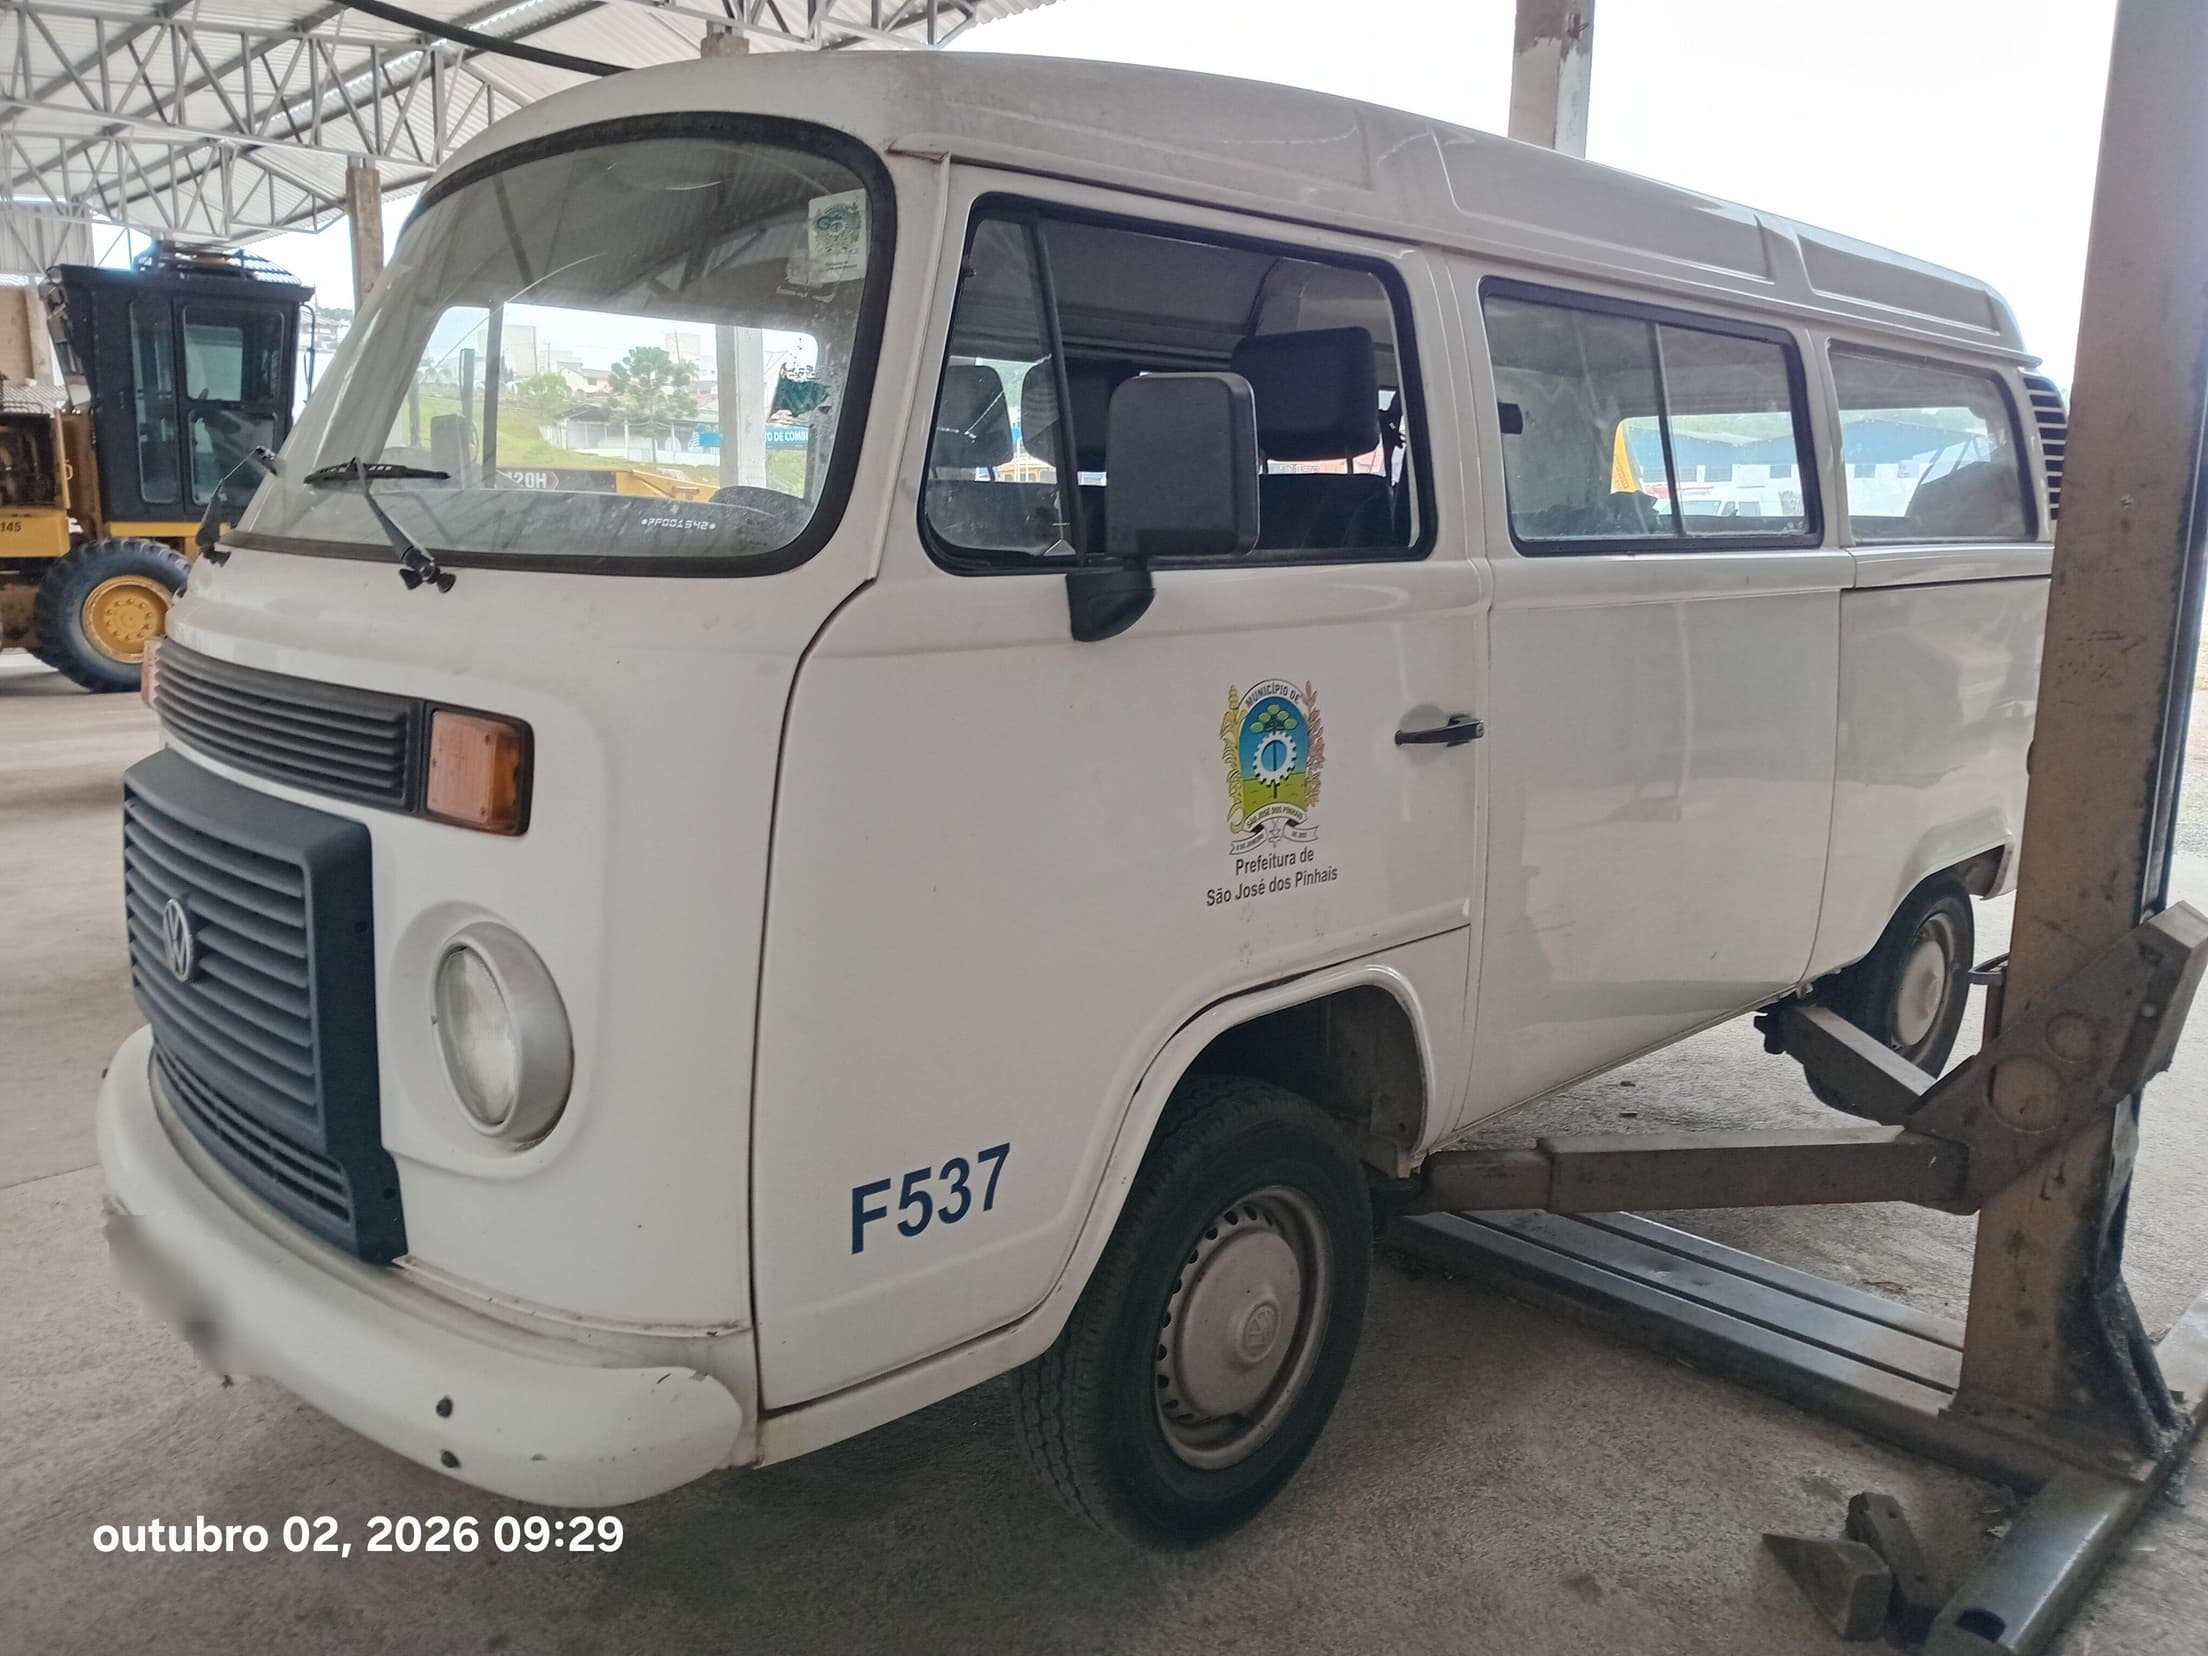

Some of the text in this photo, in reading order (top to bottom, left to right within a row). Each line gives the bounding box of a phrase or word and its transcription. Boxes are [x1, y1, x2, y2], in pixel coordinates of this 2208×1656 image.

[775, 431, 784, 442] DE
[1245, 682, 1288, 706] MUNICÍPIO
[1235, 846, 1314, 876] Prefeitura de
[1206, 865, 1338, 907] São José dos Pinhais
[851, 1142, 1010, 1255] F537
